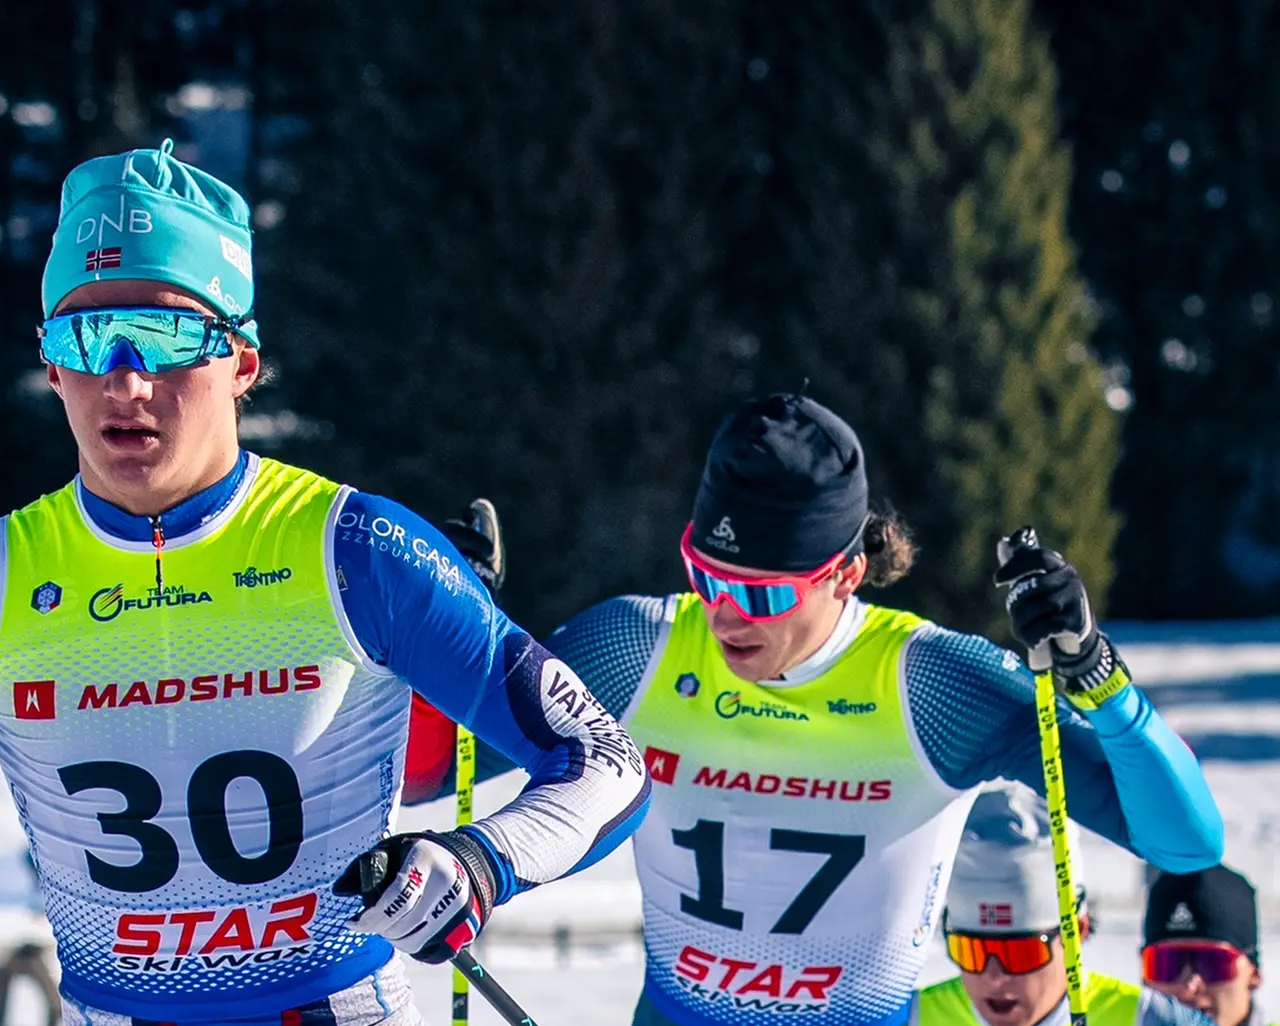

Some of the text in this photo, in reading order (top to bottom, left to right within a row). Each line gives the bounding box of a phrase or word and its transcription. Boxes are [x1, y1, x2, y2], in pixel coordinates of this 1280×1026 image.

[77, 194, 153, 244] DNB
[233, 567, 292, 588] TRENTINO
[413, 538, 460, 584] CASA
[124, 591, 213, 610] FUTURA
[77, 664, 321, 710] MADSHUS
[741, 706, 810, 721] FUTURA
[692, 766, 892, 801] MADSHUS
[57, 749, 304, 893] 30
[672, 819, 866, 935] 17
[112, 892, 319, 957] STAR
[675, 945, 843, 999] STAR
